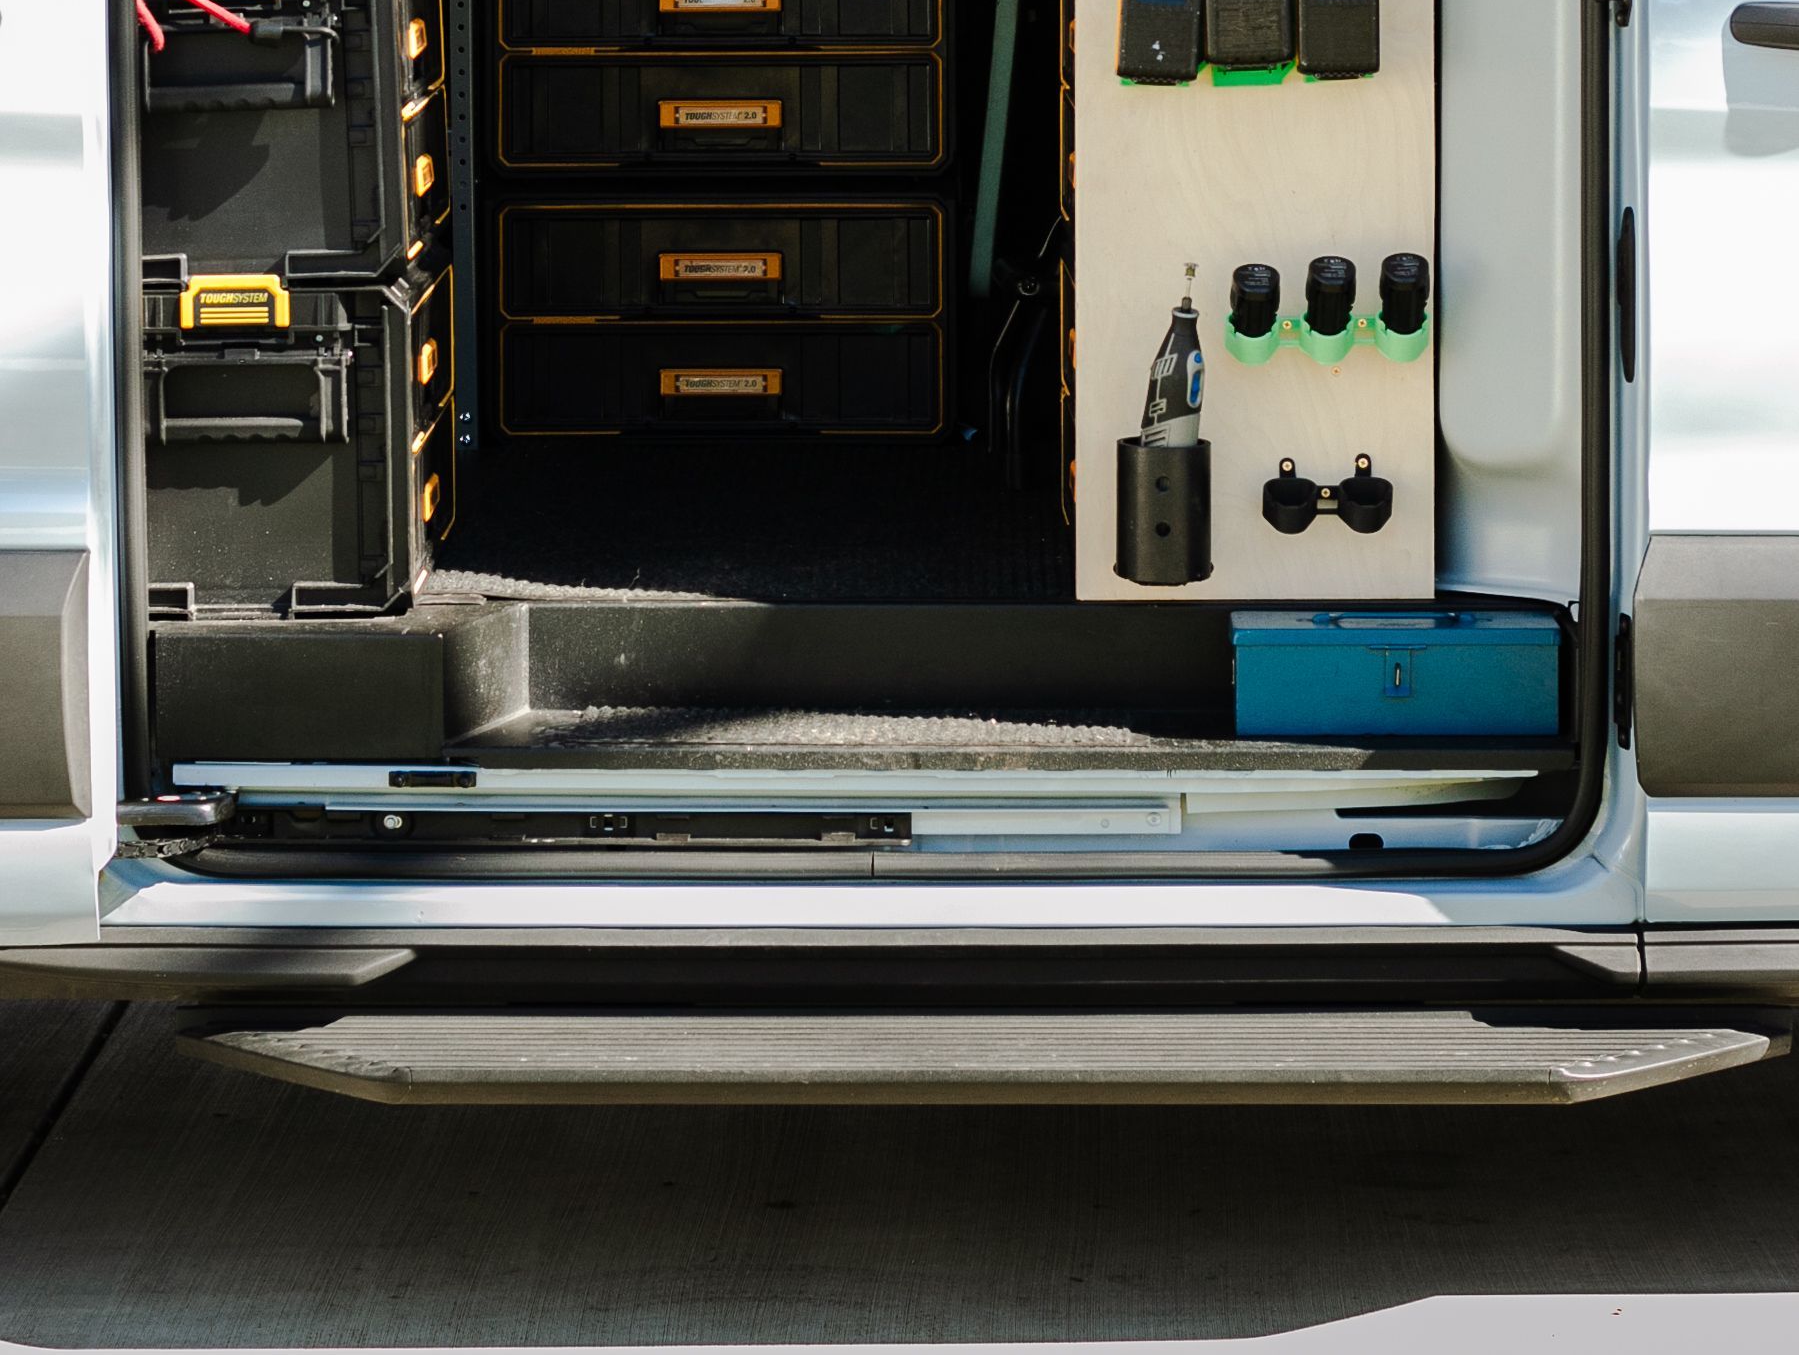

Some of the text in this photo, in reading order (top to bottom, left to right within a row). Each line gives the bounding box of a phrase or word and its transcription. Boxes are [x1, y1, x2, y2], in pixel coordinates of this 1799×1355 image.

[744, 111, 757, 120] 2.0
[199, 292, 269, 305] TOUGHSYSTEM
[744, 378, 757, 388] 2.0
